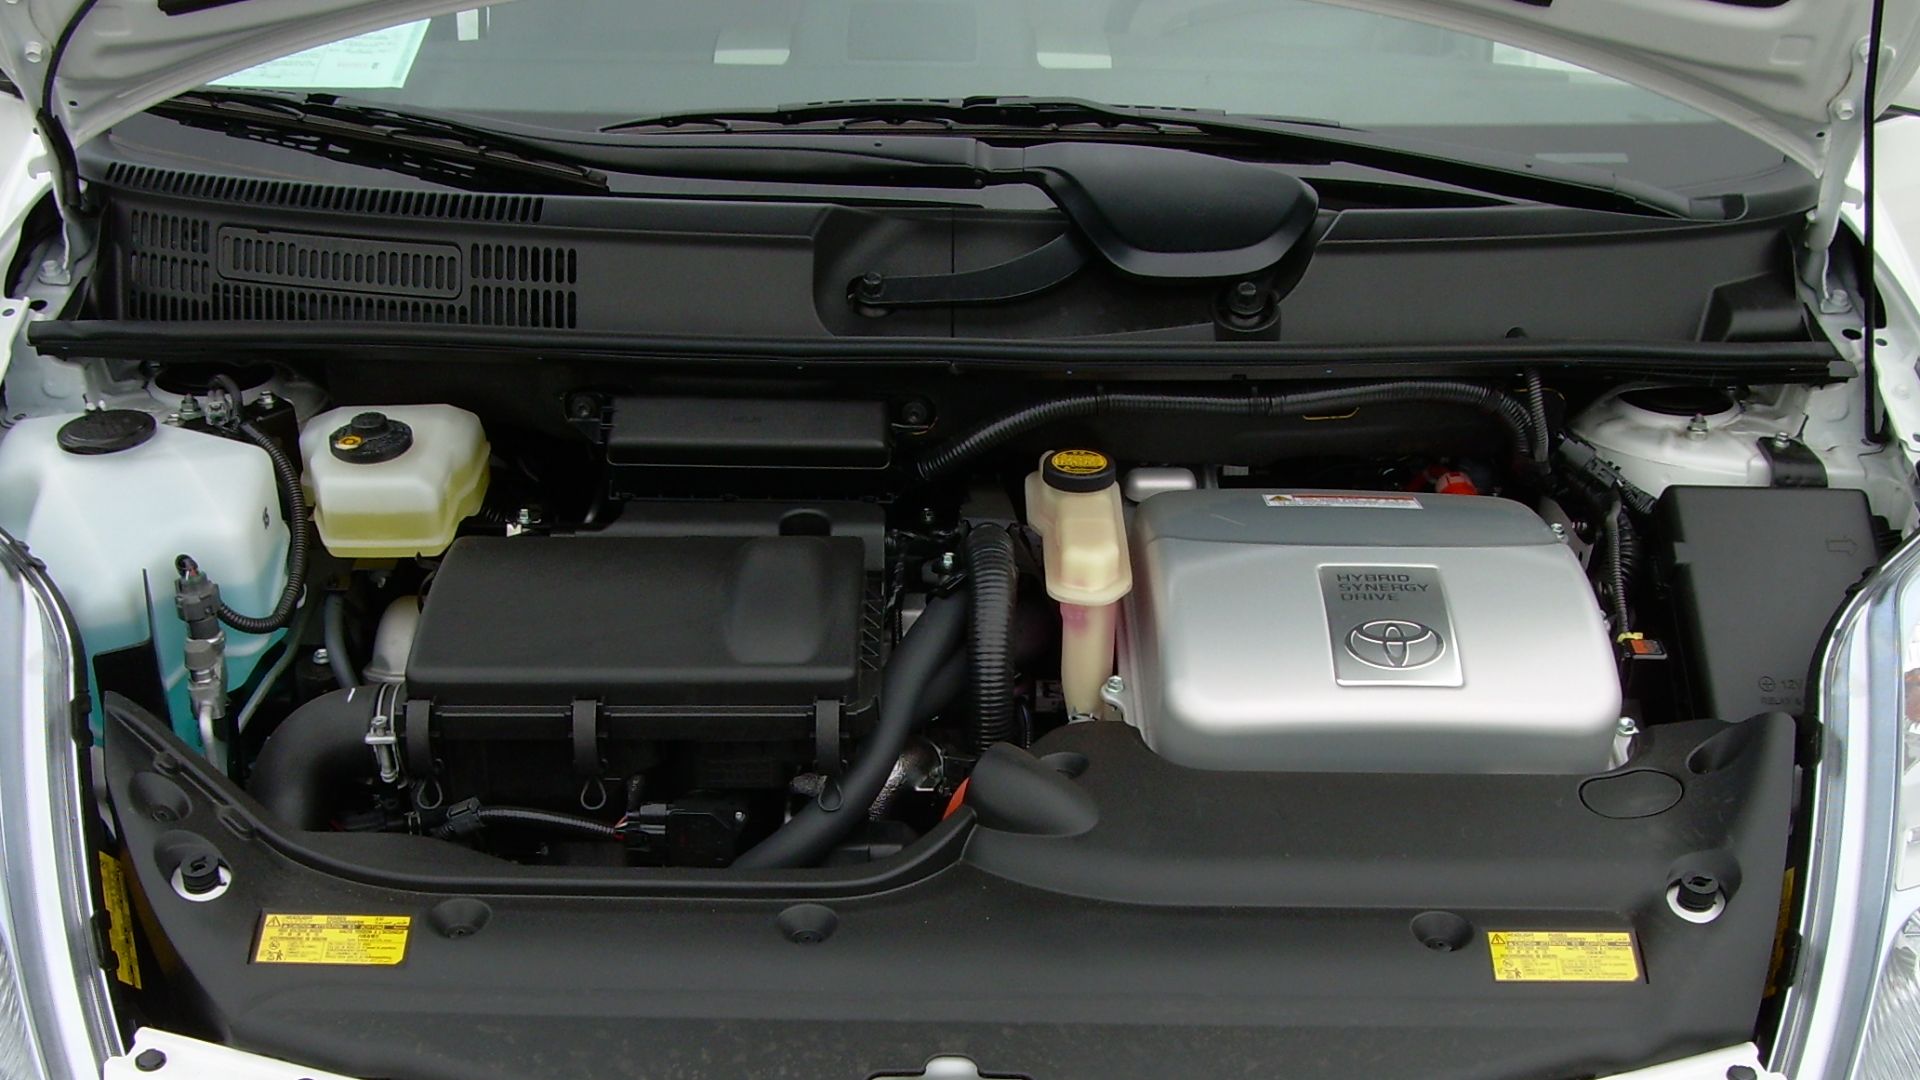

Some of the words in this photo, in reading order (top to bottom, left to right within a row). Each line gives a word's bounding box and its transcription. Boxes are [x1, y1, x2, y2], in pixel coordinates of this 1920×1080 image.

[1337, 574, 1410, 583] HYBRID
[1338, 583, 1429, 592] SYNERGY
[1340, 593, 1400, 601] DRIVE
